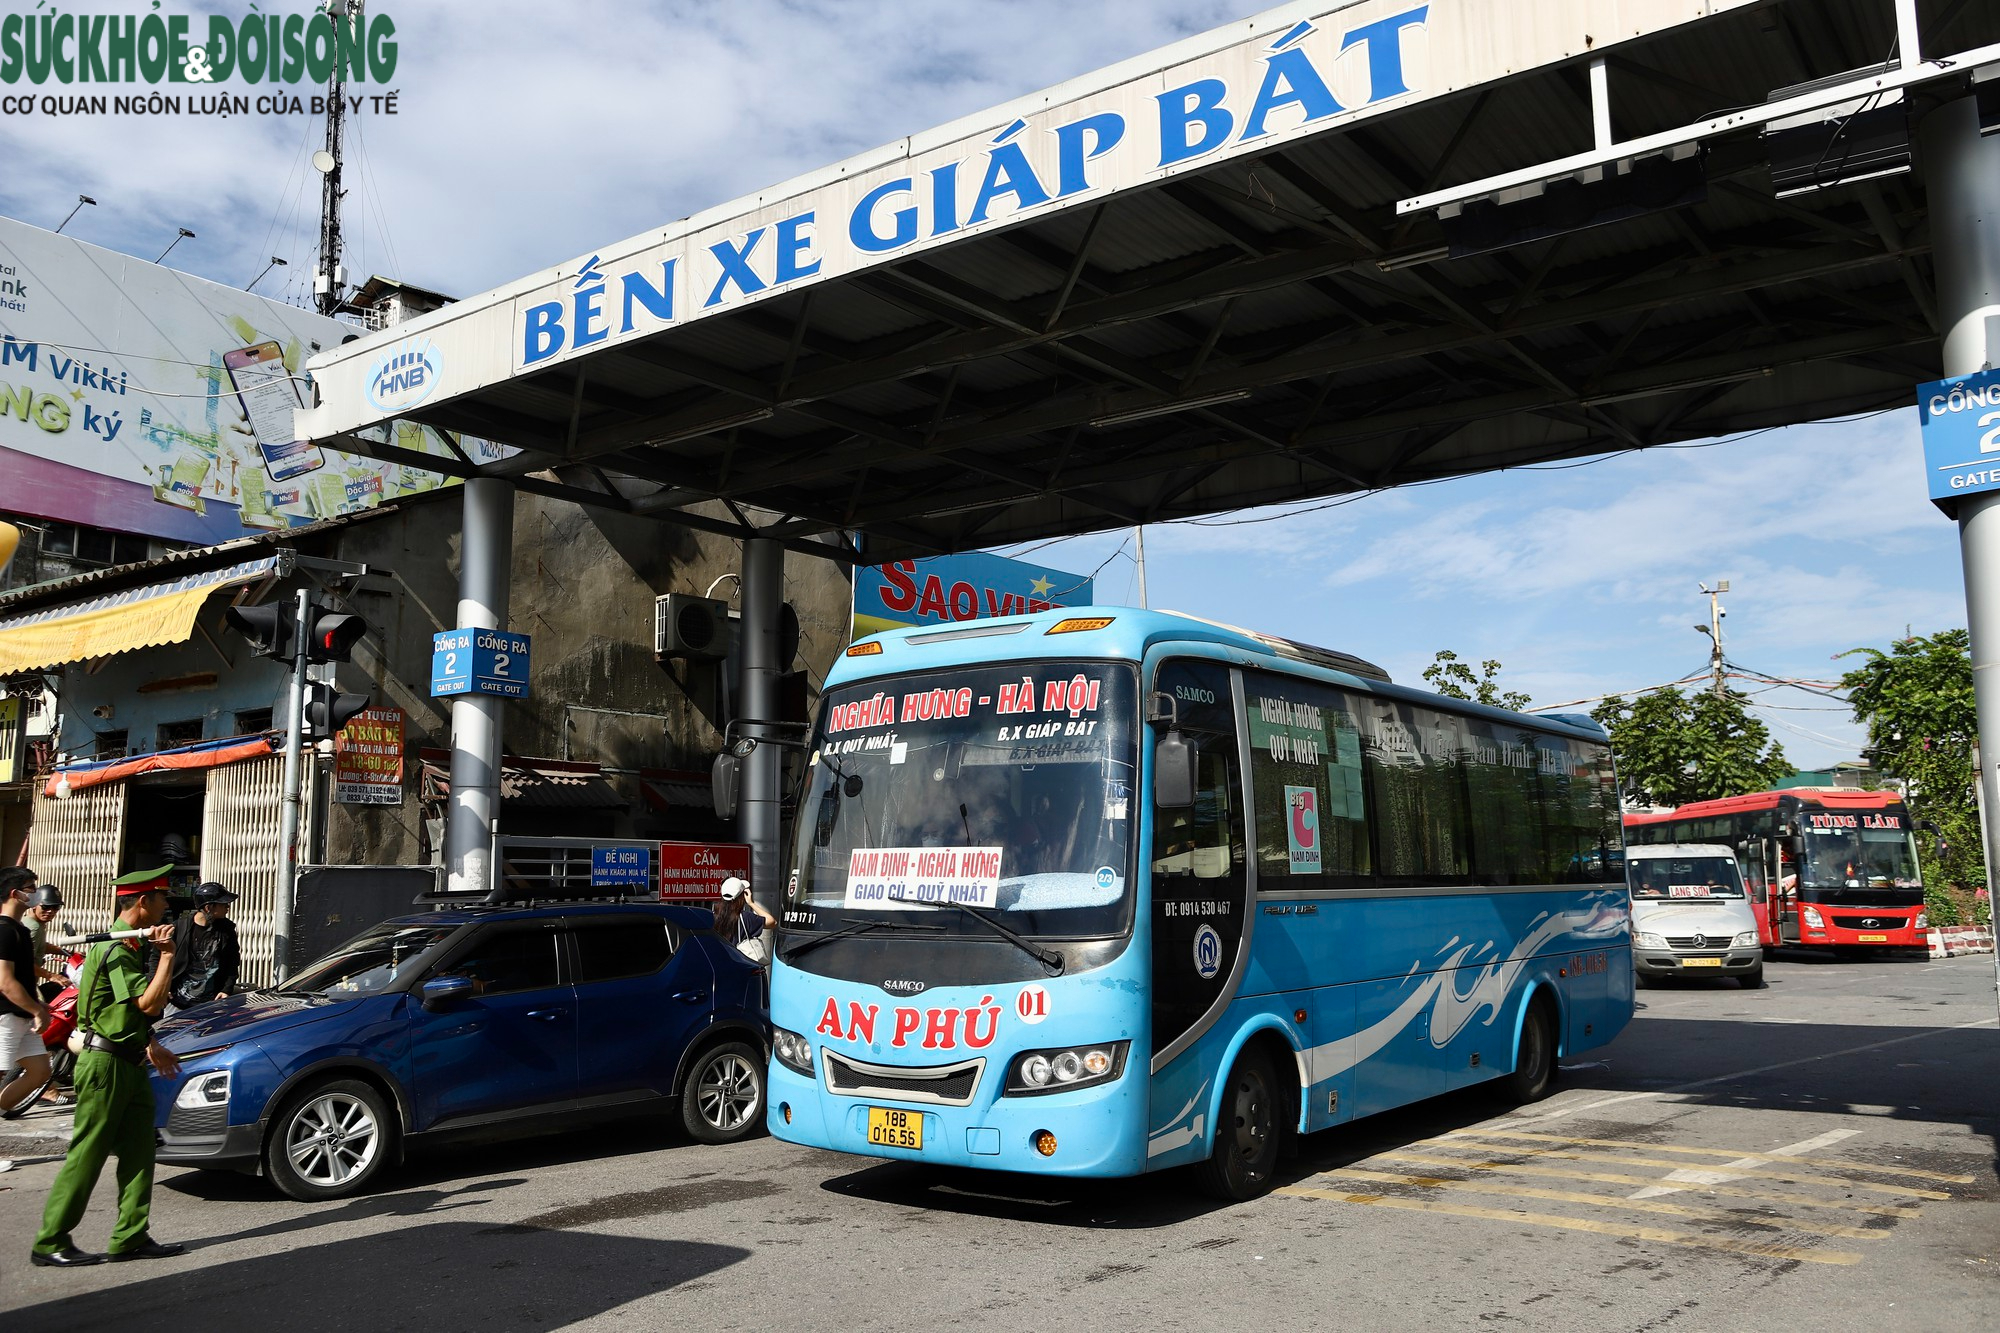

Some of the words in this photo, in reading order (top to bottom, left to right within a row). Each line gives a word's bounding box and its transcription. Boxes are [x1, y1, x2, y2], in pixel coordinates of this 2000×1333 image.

[521, 254, 681, 366] BẾN
[702, 210, 824, 308] XE
[847, 118, 1126, 252] GIÁP
[1156, 4, 1430, 168] BÁT
[49, 353, 128, 396] Vikki
[379, 366, 425, 397] HNB
[1929, 382, 2000, 416] CỔNG
[83, 404, 123, 442] ký
[1950, 469, 2000, 489] GATE
[878, 559, 979, 622] SAO
[434, 634, 456, 652] CỔNG
[458, 636, 470, 648] RA
[477, 632, 508, 651] CỔNG
[511, 641, 528, 654] RA
[444, 652, 457, 675] 2
[493, 653, 510, 676] 2
[436, 682, 452, 692] GATE
[453, 681, 465, 690] OUT
[481, 682, 502, 692] GATE
[504, 685, 521, 694] OUT
[1175, 685, 1215, 704] SAMCO
[828, 691, 895, 734] NGHĨA
[900, 687, 972, 723] HƯNG
[996, 676, 1036, 714] HÀ
[1042, 674, 1101, 718] NỘI
[1260, 695, 1293, 726] NGHĨA
[1293, 702, 1322, 731] HƯNG
[997, 725, 1023, 741] B.X
[1025, 719, 1062, 739] GIÁP
[1064, 718, 1098, 736] BÁT
[823, 741, 842, 756] B.X
[842, 734, 865, 755] QUỸ
[865, 730, 898, 751] NHẤT
[1269, 732, 1290, 763] QUỸ
[1293, 734, 1319, 766] NHẤT
[1810, 812, 1857, 828] TÙNG
[1862, 813, 1901, 829] LÂM
[605, 847, 617, 863] ĐỀ
[619, 852, 638, 866] NGHỊ
[693, 849, 719, 865] CẤM
[850, 853, 879, 877] NAM
[880, 852, 910, 881] ĐỊNH
[917, 849, 957, 878] NGHĨA
[960, 850, 999, 879] HƯNG
[1291, 851, 1305, 862] NAM
[593, 866, 608, 876] HÀNH
[609, 866, 627, 876] KHÁCH
[628, 869, 639, 877] MUA
[664, 868, 681, 878] HÀNH
[681, 868, 701, 879] KHÁCH
[701, 867, 709, 878] VÀ
[1098, 873, 1113, 883] 2/3
[664, 884, 670, 894] ĐI
[671, 882, 684, 894] VÀO
[684, 882, 704, 894] ĐƯỜNG
[854, 883, 885, 900] GIAO
[947, 880, 988, 902] NHẤT
[1165, 902, 1178, 917] ĐT:
[1180, 902, 1200, 916] 0914
[1201, 901, 1216, 915] 530
[1217, 901, 1231, 915] 467
[883, 979, 925, 991] SAMCO
[1018, 990, 1047, 1017] 01
[816, 996, 880, 1046] AN
[890, 995, 1004, 1049] PHÚ
[885, 1111, 907, 1127] 18B
[873, 1126, 916, 1146] 016.56
